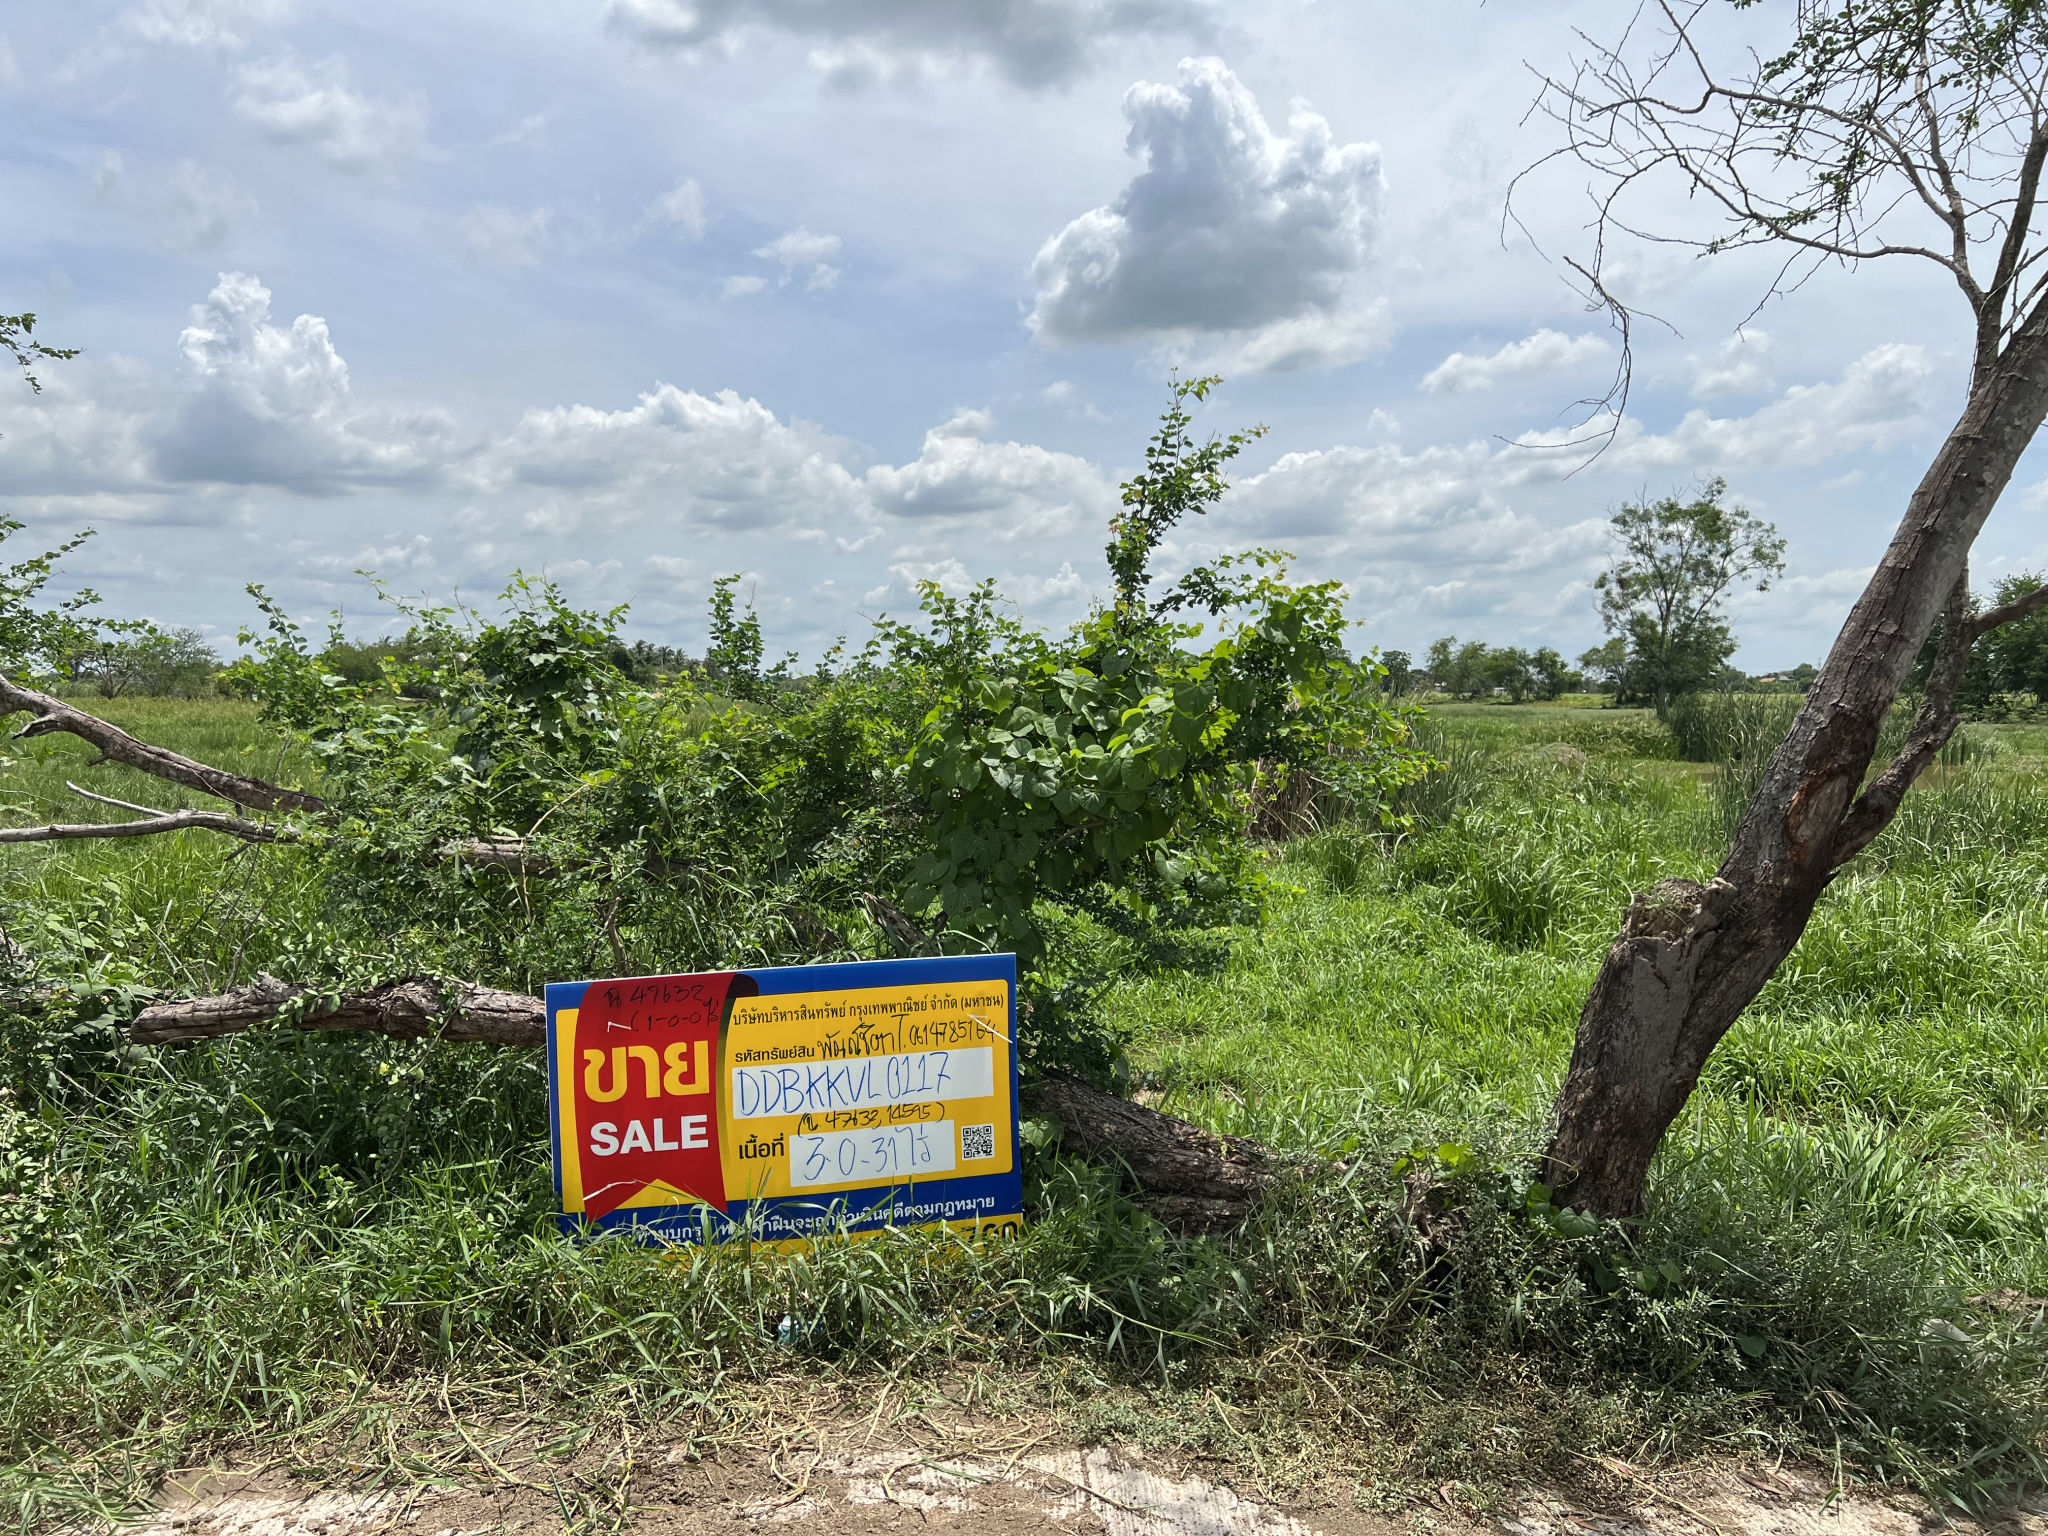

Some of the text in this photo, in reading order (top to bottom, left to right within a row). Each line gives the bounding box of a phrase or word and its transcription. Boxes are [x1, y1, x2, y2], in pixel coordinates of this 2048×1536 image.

[733, 992, 1004, 1026] บริษัทบริหารสินทรัพย์ กรุงเทพพาณิชย์ จำกัด (มหาชน)
[735, 1045, 815, 1064] รหัสทรัพย์สิน
[583, 1040, 710, 1104] ขาย
[589, 1114, 709, 1156] SALE
[739, 1132, 784, 1160] เนื้อที่
